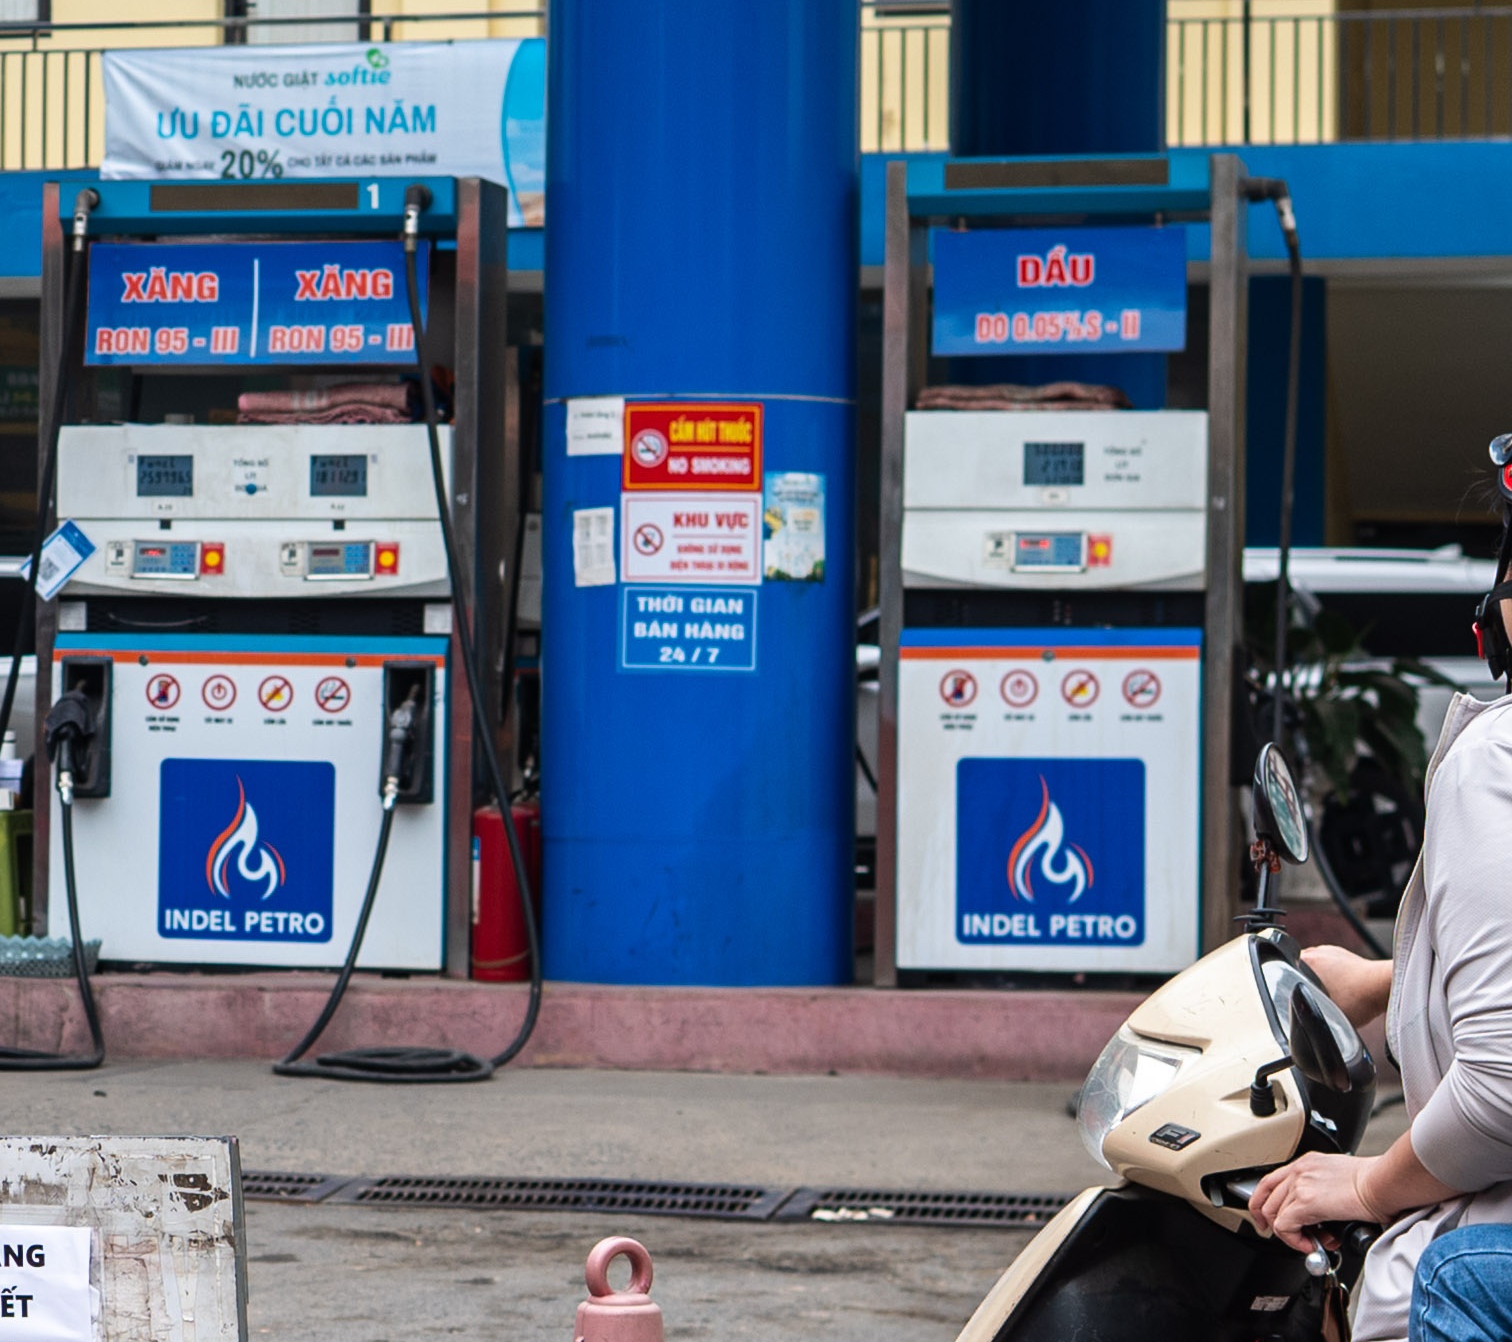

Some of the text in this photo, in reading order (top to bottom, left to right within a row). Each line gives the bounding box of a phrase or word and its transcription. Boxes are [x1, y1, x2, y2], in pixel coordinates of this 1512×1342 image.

[233, 63, 391, 90] NƯỚC GIẶT softie
[157, 94, 436, 140] ƯU ĐÃI CUỐI NĂM
[221, 148, 284, 179] 20%
[367, 183, 379, 210] 1
[122, 267, 219, 303] XĂNG
[295, 264, 393, 300] XĂNG
[268, 325, 326, 354] RON
[330, 324, 364, 353] 95
[385, 323, 414, 352] III
[975, 308, 1142, 343] DO 0.05%S II
[95, 327, 151, 355] RON
[155, 326, 189, 354] 95
[210, 326, 240, 354] III
[673, 512, 750, 532] KHU VỰC
[637, 594, 744, 615] THỜI GIAN
[633, 618, 745, 641] BÁN HÀNG
[659, 646, 685, 663] 24
[707, 648, 720, 663] 7
[164, 908, 325, 935] INDEL PETRO
[962, 913, 1137, 939] INDEL PETRO
